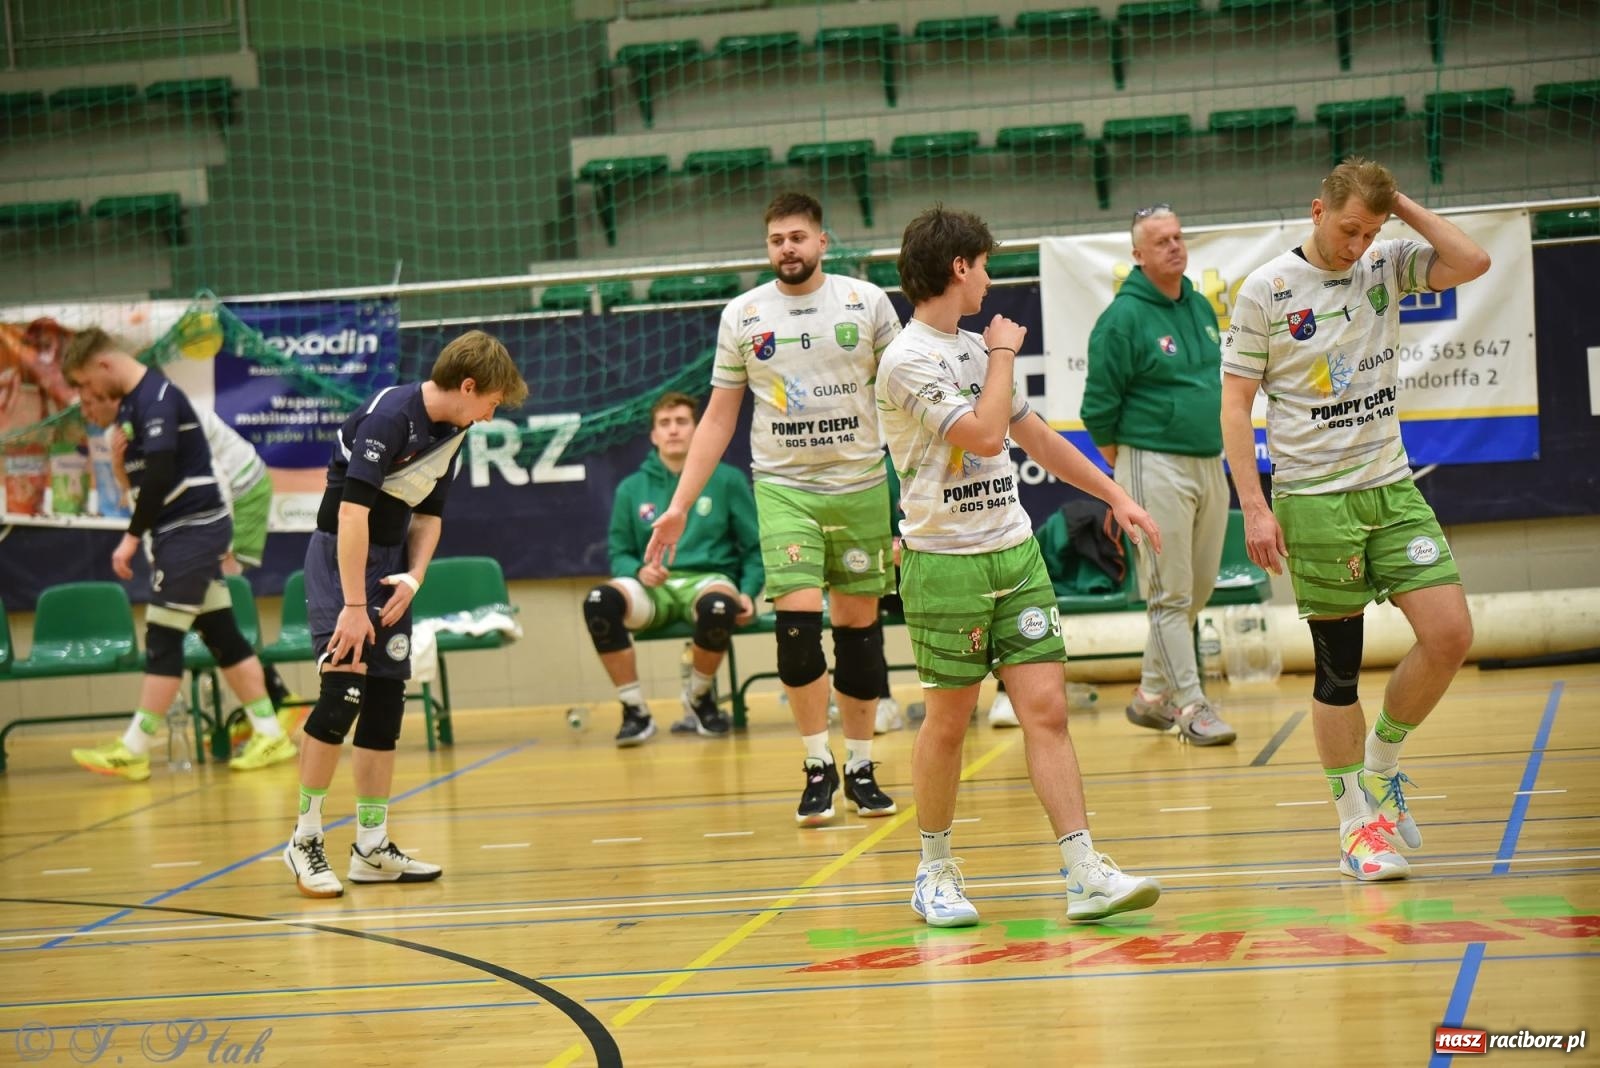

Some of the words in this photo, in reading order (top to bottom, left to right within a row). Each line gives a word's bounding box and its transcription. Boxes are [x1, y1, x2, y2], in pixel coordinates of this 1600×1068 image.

[801, 332, 811, 350] 6
[1400, 344, 1423, 362] 06
[1429, 341, 1466, 362] 363
[1473, 339, 1511, 358] 647
[1067, 355, 1086, 372] te
[1398, 370, 1480, 391] endorffa
[1486, 369, 1499, 386] 2
[813, 382, 858, 397] GUARD
[1311, 397, 1362, 420] POMPY
[771, 420, 815, 436] POMPY
[1328, 418, 1354, 429] 605
[453, 412, 587, 488] RZ
[785, 438, 807, 448] 605
[810, 436, 834, 447] 944
[943, 480, 991, 504] POMPY
[959, 501, 984, 513] 605
[986, 497, 1007, 510] 944
[1050, 606, 1062, 638] 9
